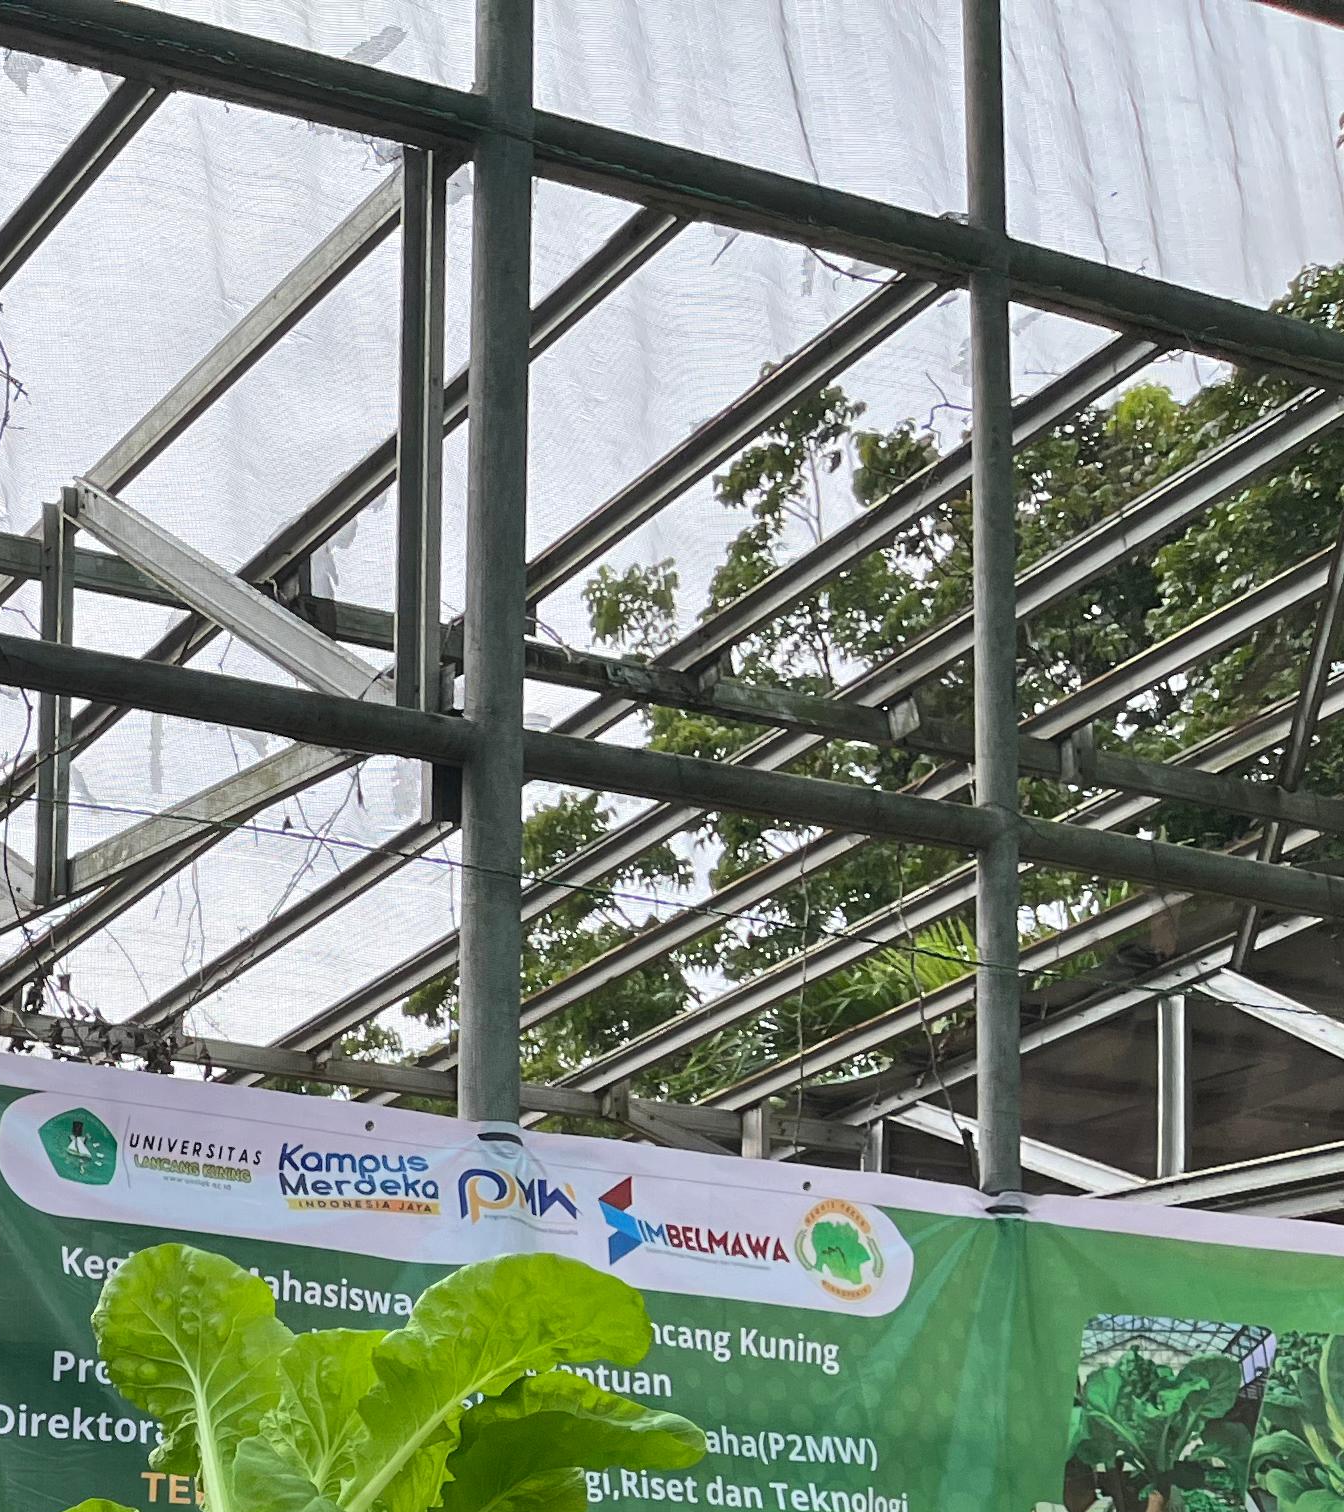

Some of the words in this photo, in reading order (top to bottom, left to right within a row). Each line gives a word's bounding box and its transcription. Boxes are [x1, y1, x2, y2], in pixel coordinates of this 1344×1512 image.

[129, 1132, 263, 1166] UNIVERSITAS
[278, 1142, 430, 1178] Kampus
[133, 1153, 200, 1177] LANCANG
[202, 1162, 253, 1184] KUNING
[279, 1172, 440, 1200] Merdeka
[297, 1199, 391, 1210] INDONESIA
[249, 1268, 413, 1316] ahasiswa
[650, 1323, 732, 1362] ncang
[740, 1327, 840, 1374] Kuning
[705, 1425, 878, 1471] aha(P2MW)
[707, 1475, 763, 1509] dan
